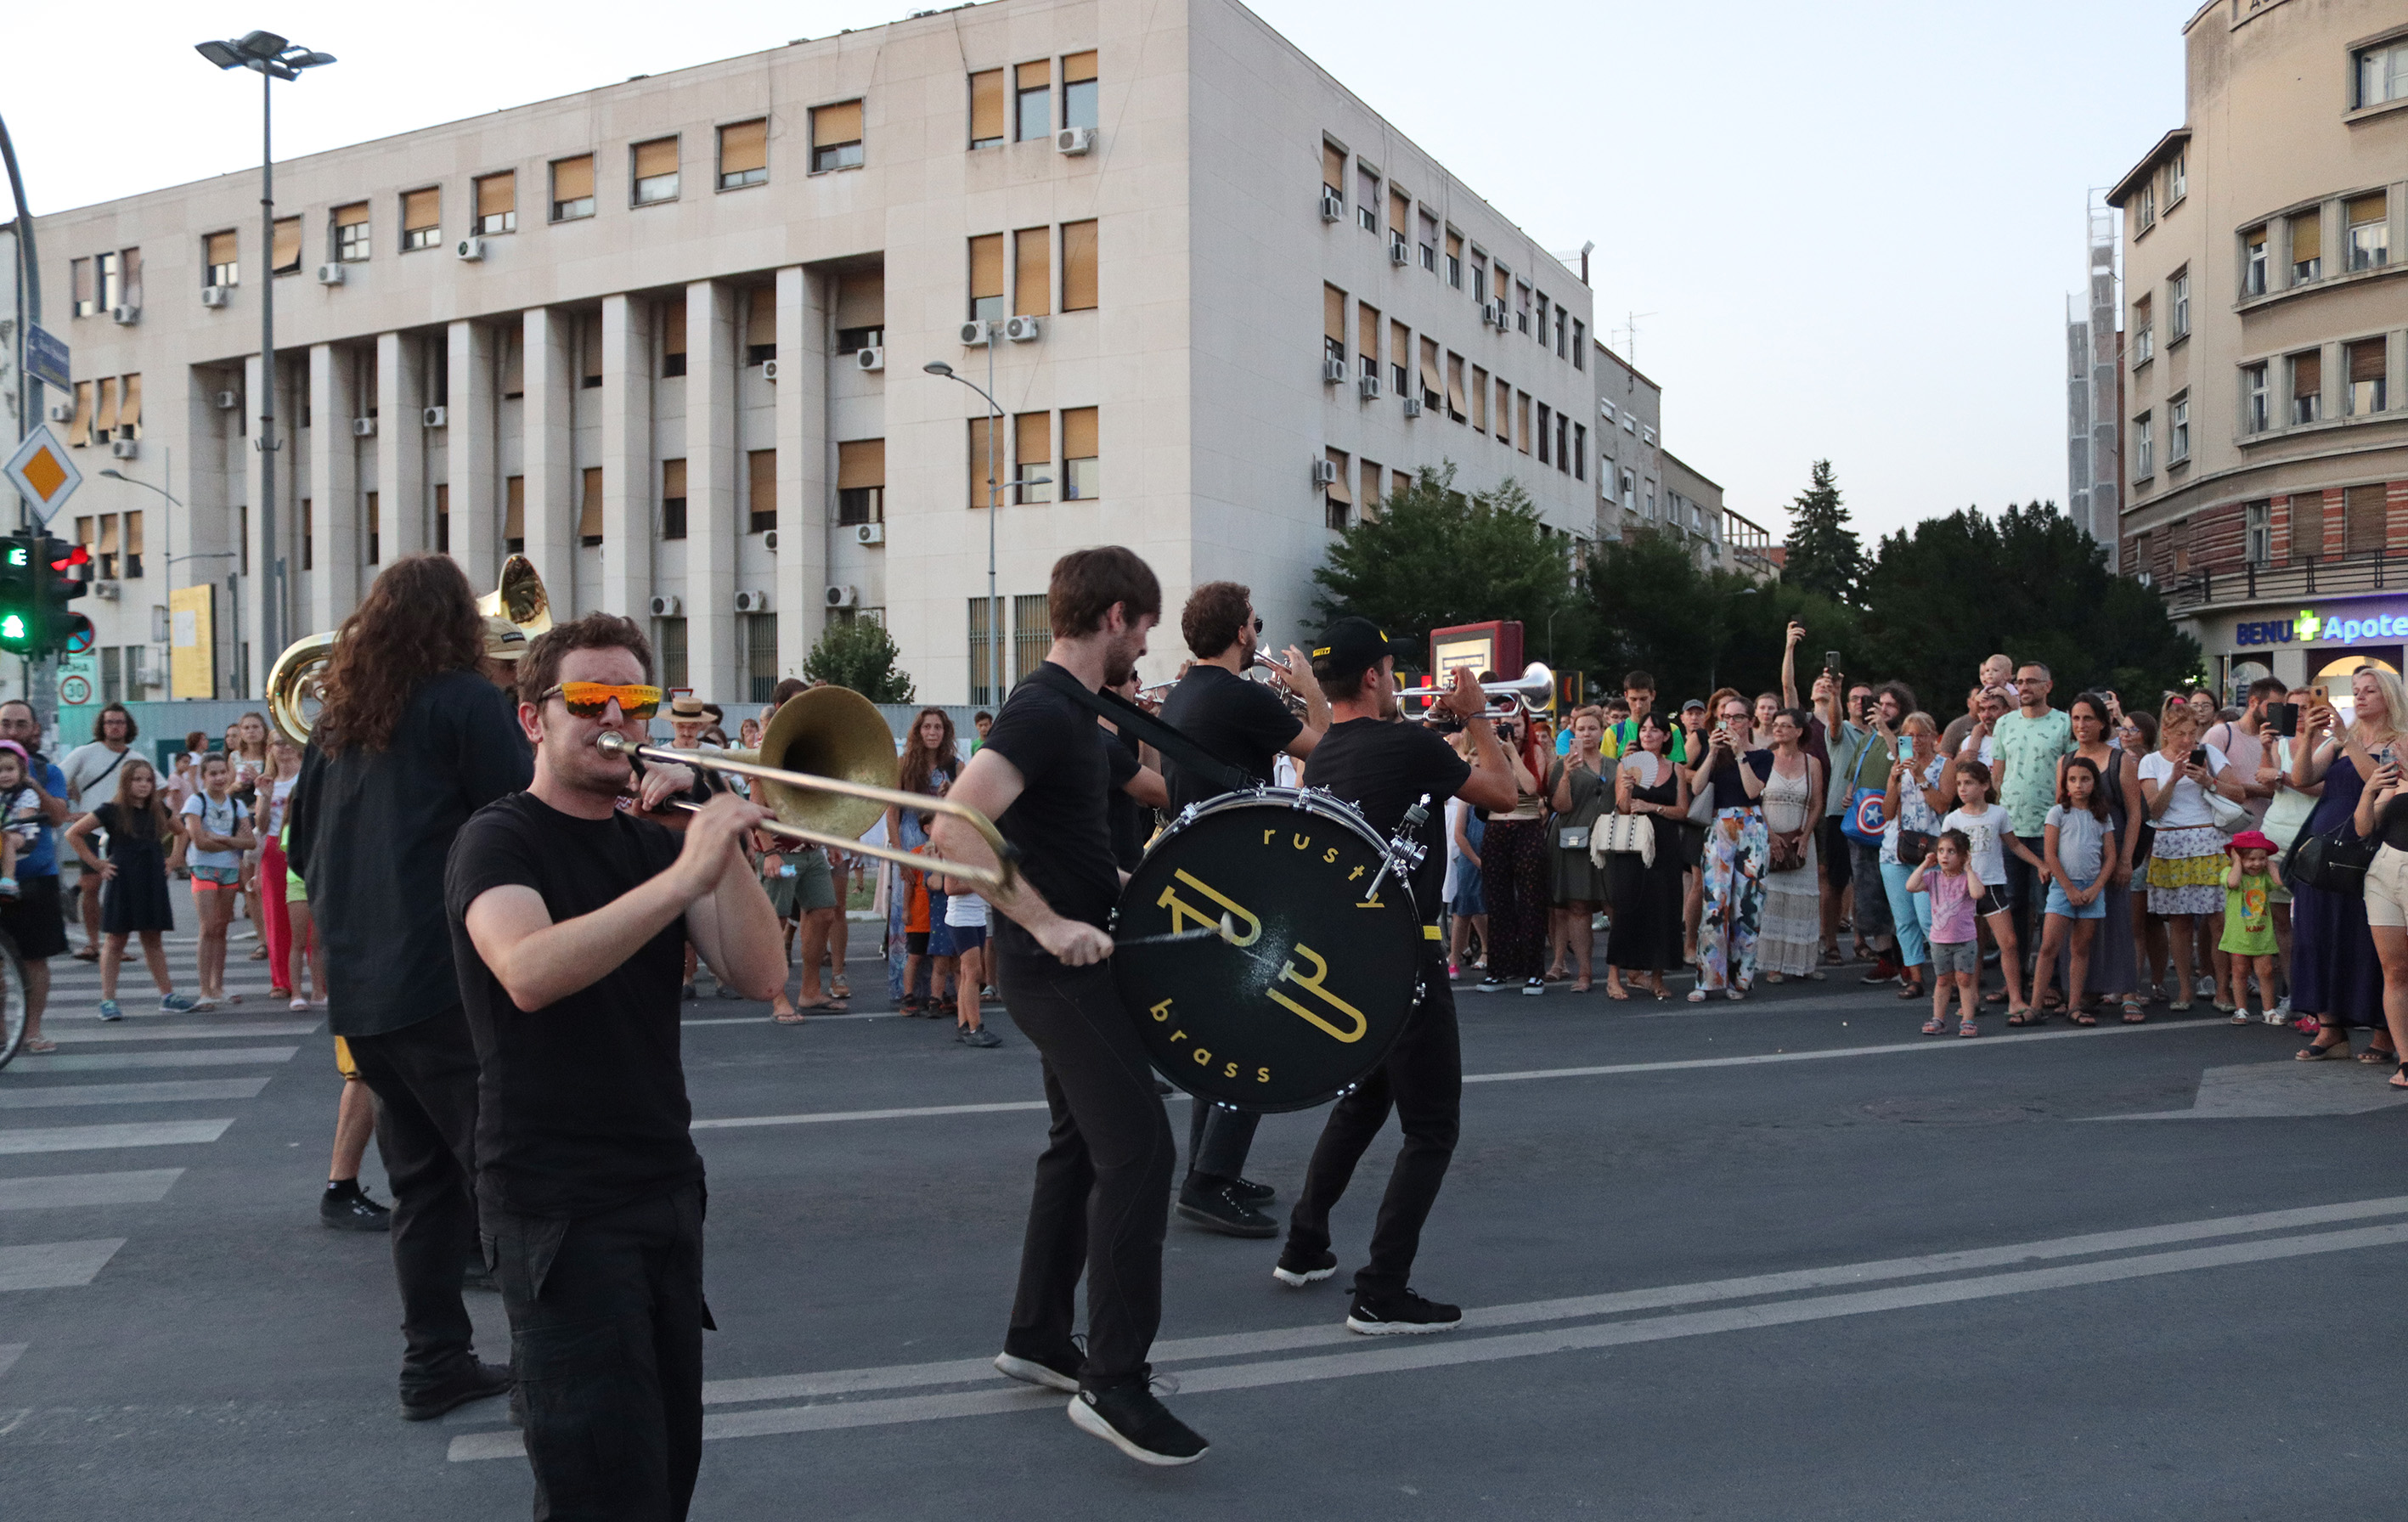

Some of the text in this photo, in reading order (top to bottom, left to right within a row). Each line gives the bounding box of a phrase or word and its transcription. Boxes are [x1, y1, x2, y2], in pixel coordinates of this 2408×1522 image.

[2236, 619, 2293, 646] BENU
[67, 683, 84, 697] 30
[1263, 828, 1385, 909] rusty
[1149, 997, 1271, 1084] brass
